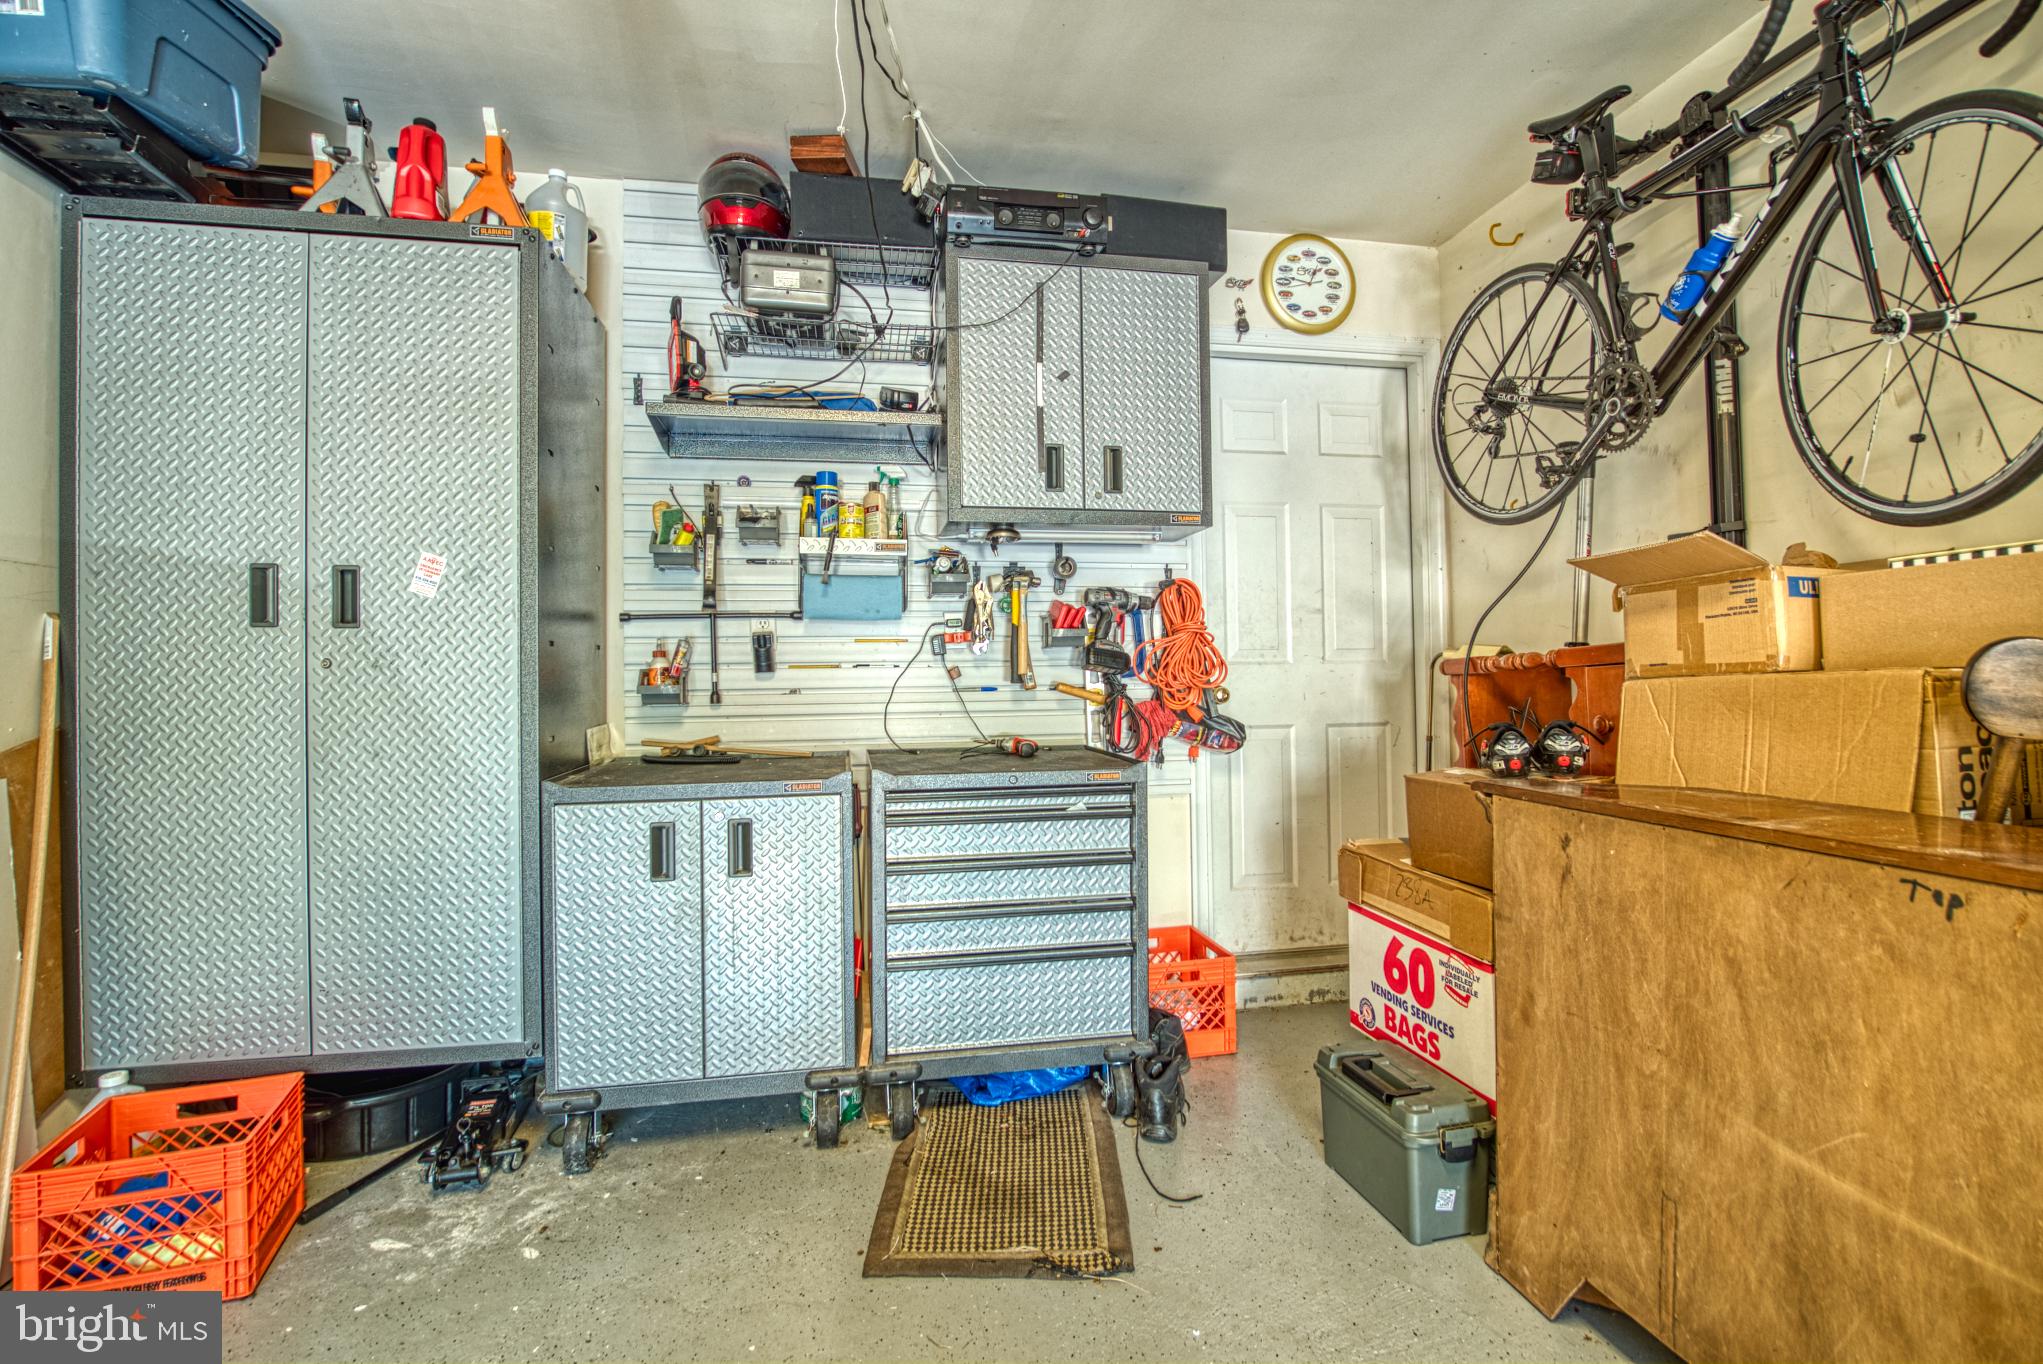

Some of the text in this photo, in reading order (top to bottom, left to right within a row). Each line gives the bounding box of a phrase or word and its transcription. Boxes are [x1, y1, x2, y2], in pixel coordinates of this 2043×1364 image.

[1383, 935, 1436, 1010] 60
[1438, 959, 1481, 984] INDIVIDUALLY
[1441, 975, 1454, 987] FOR
[1454, 981, 1479, 999] RESALE
[1445, 970, 1474, 988] LABELED
[1371, 980, 1409, 1013] VENDING
[1410, 1005, 1455, 1039] SERVICES
[1384, 1003, 1441, 1061] BAGS
